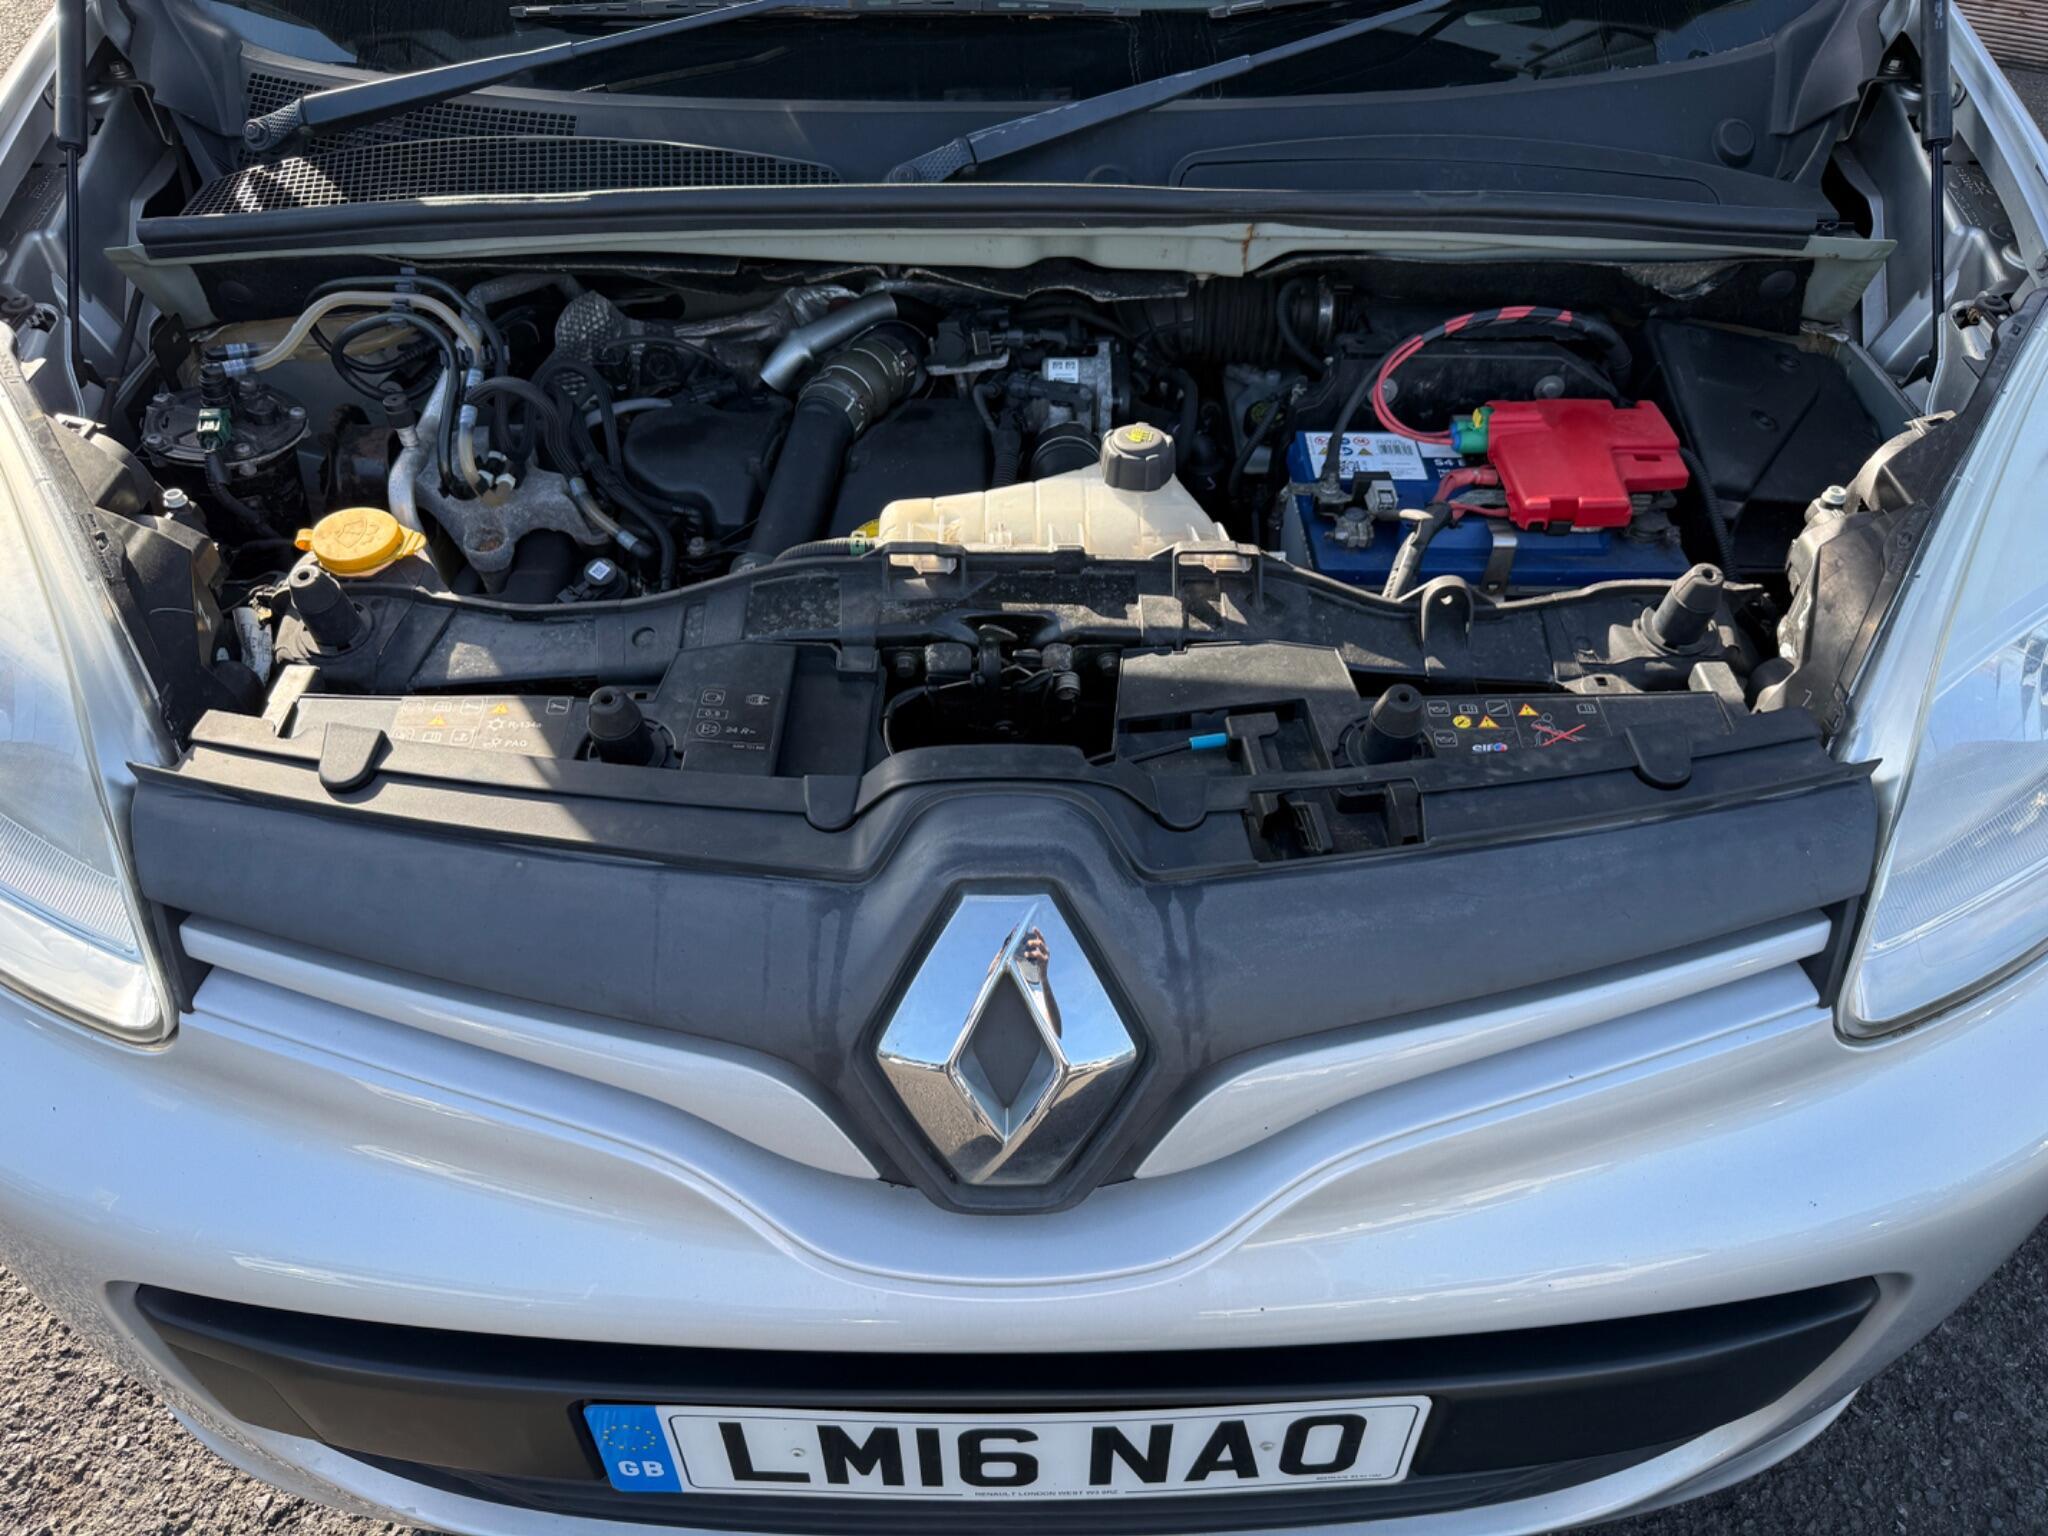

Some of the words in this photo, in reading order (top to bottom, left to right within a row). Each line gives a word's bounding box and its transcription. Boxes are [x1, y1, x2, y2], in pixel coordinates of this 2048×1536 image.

[1472, 743, 1494, 752] elf
[718, 1421, 1038, 1487] LM16
[617, 1460, 665, 1477] GB
